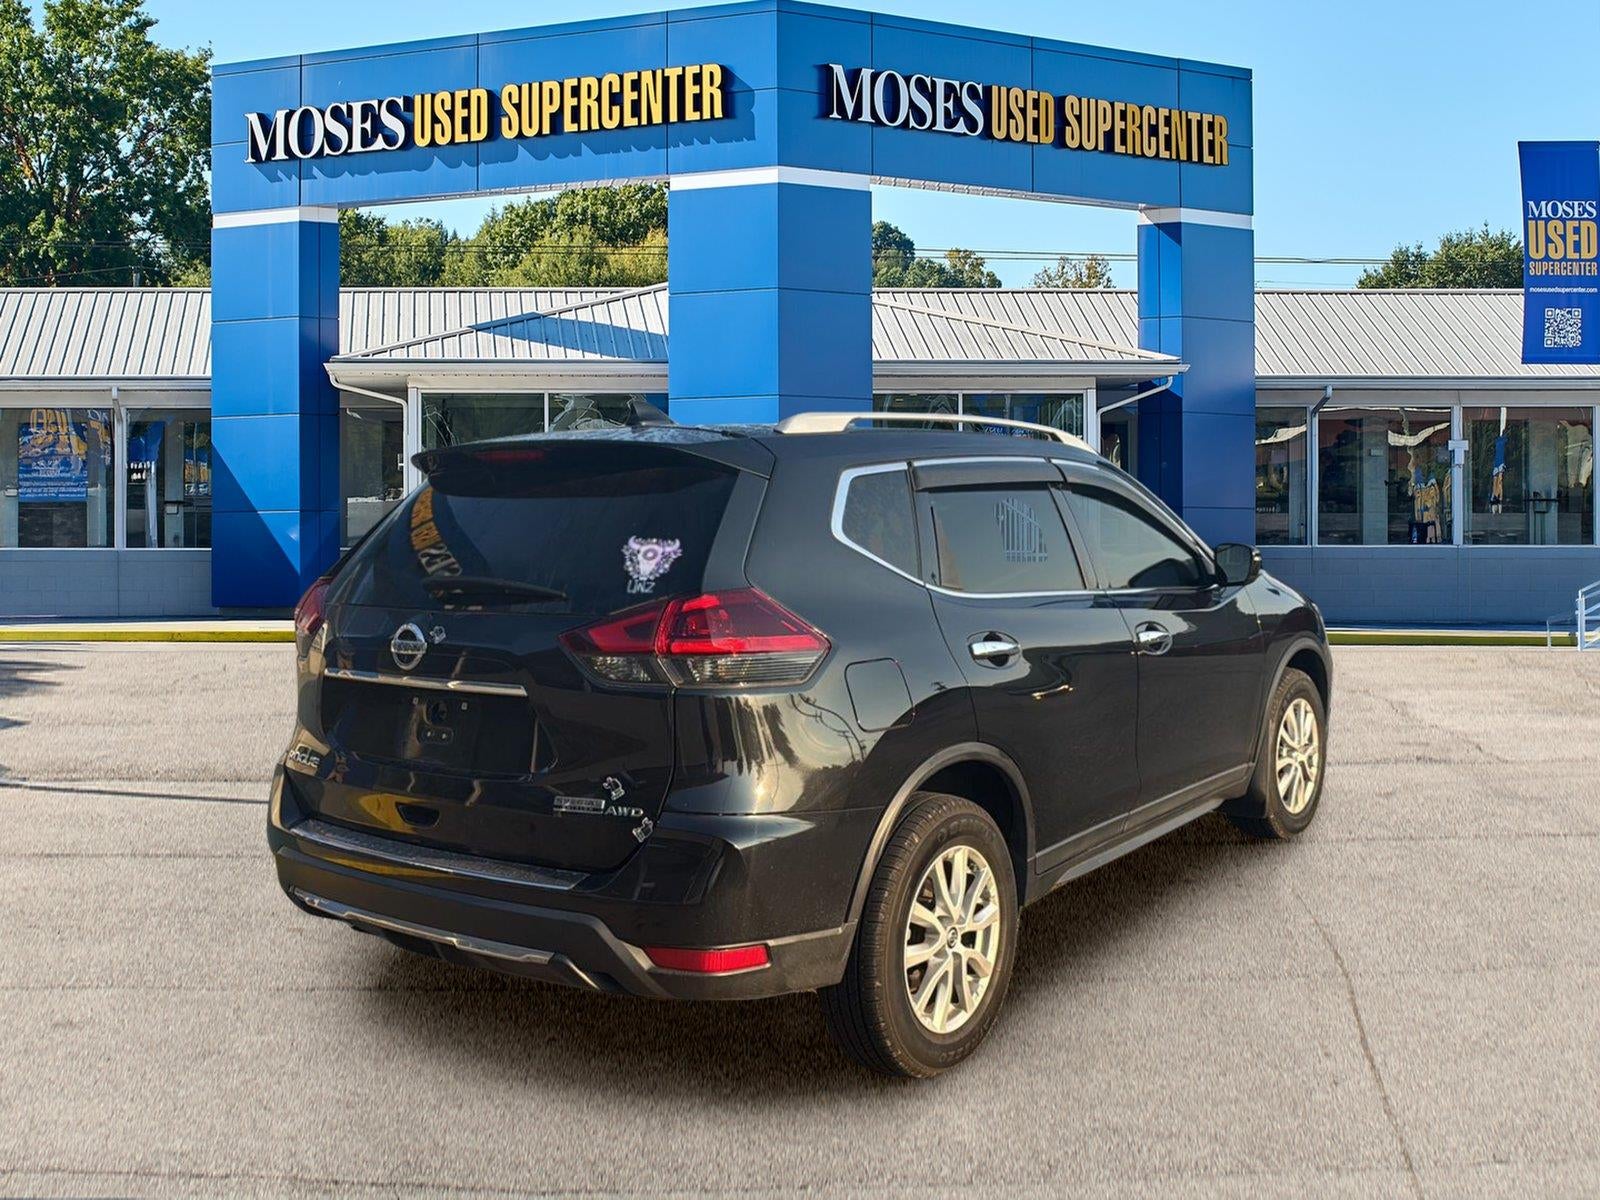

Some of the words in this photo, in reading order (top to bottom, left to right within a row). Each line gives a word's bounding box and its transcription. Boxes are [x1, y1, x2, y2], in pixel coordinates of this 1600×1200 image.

[245, 97, 405, 163] MOSES
[413, 87, 488, 147] USED
[501, 63, 724, 139] SUPERCENTER
[828, 63, 984, 136] MOSES
[991, 85, 1055, 144] USED
[1064, 94, 1229, 165] SUPERCENTER
[1527, 200, 1597, 218] MOSES
[1528, 220, 1598, 260] USED
[1529, 261, 1598, 276] SUPERCENTER
[605, 805, 644, 818] AWD
